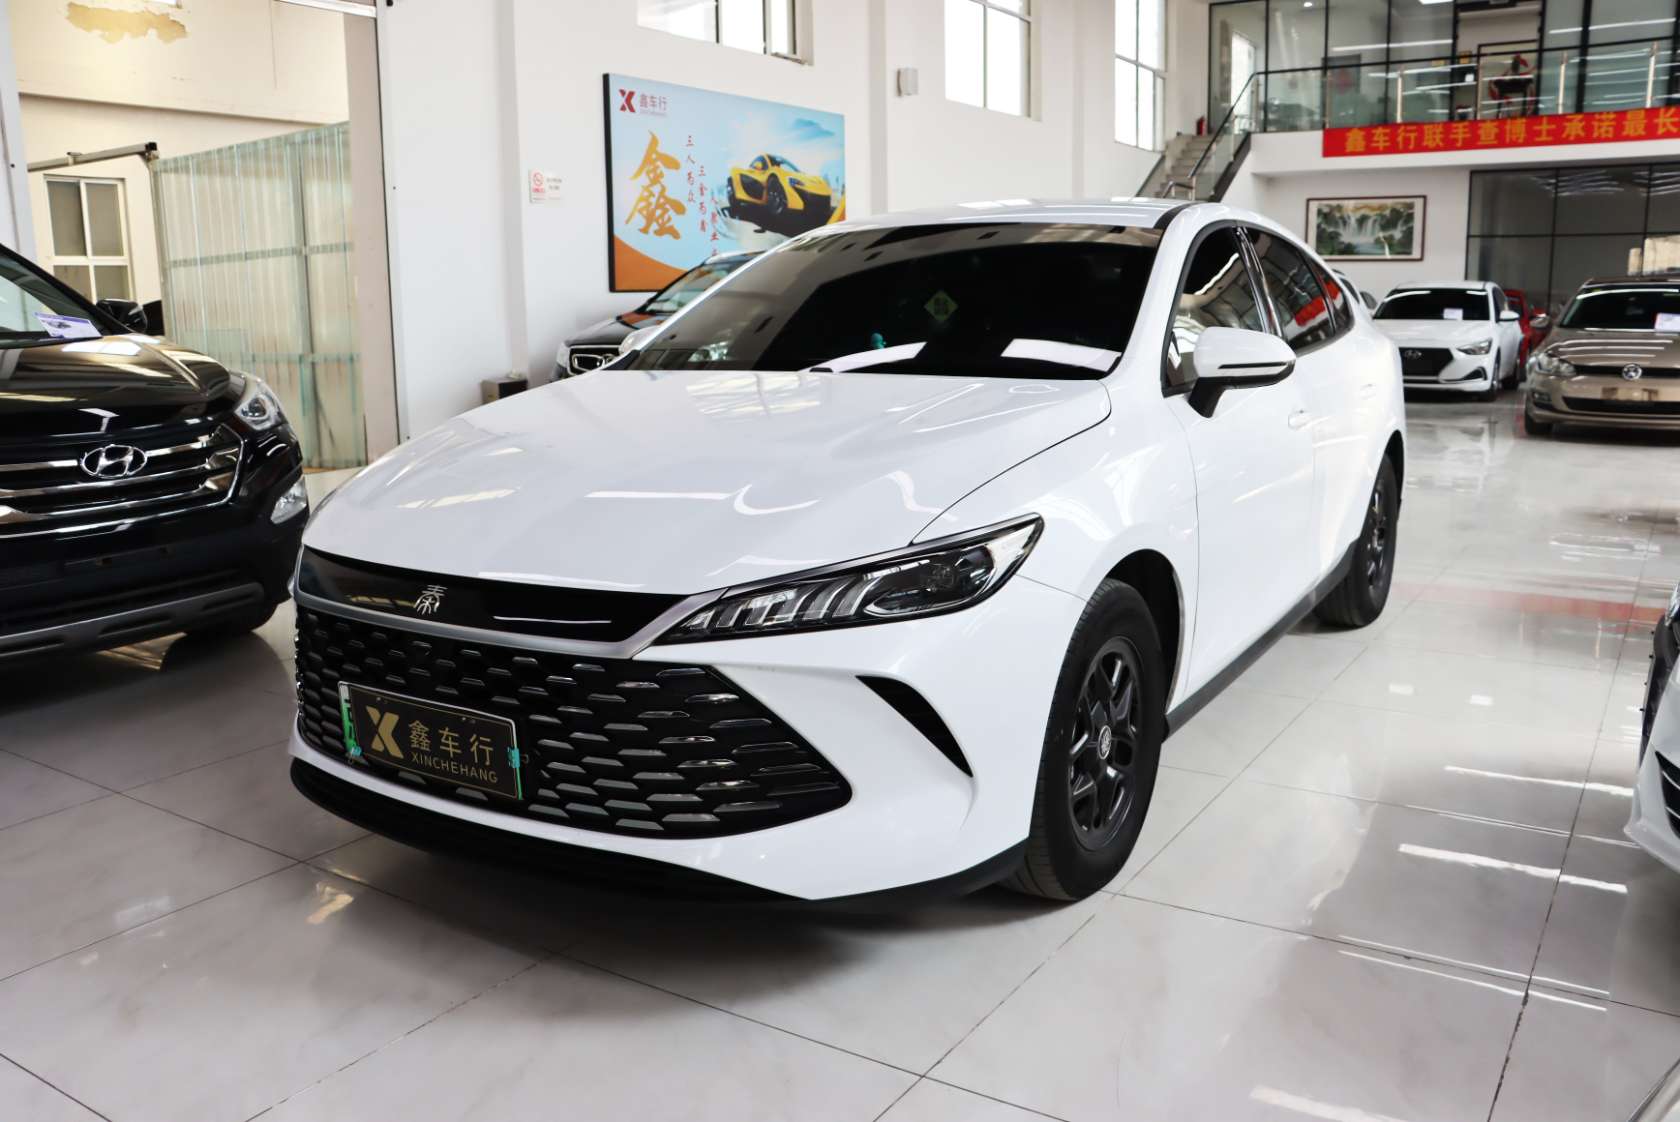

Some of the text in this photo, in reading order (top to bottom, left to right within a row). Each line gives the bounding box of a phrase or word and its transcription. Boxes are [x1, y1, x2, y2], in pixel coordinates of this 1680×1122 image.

[640, 93, 667, 111] 鑫车行
[1345, 106, 1680, 153] 鑫车行联手查博士承诺最长
[408, 720, 494, 767] 鑫车行
[411, 752, 498, 784] XINCHEHANG
